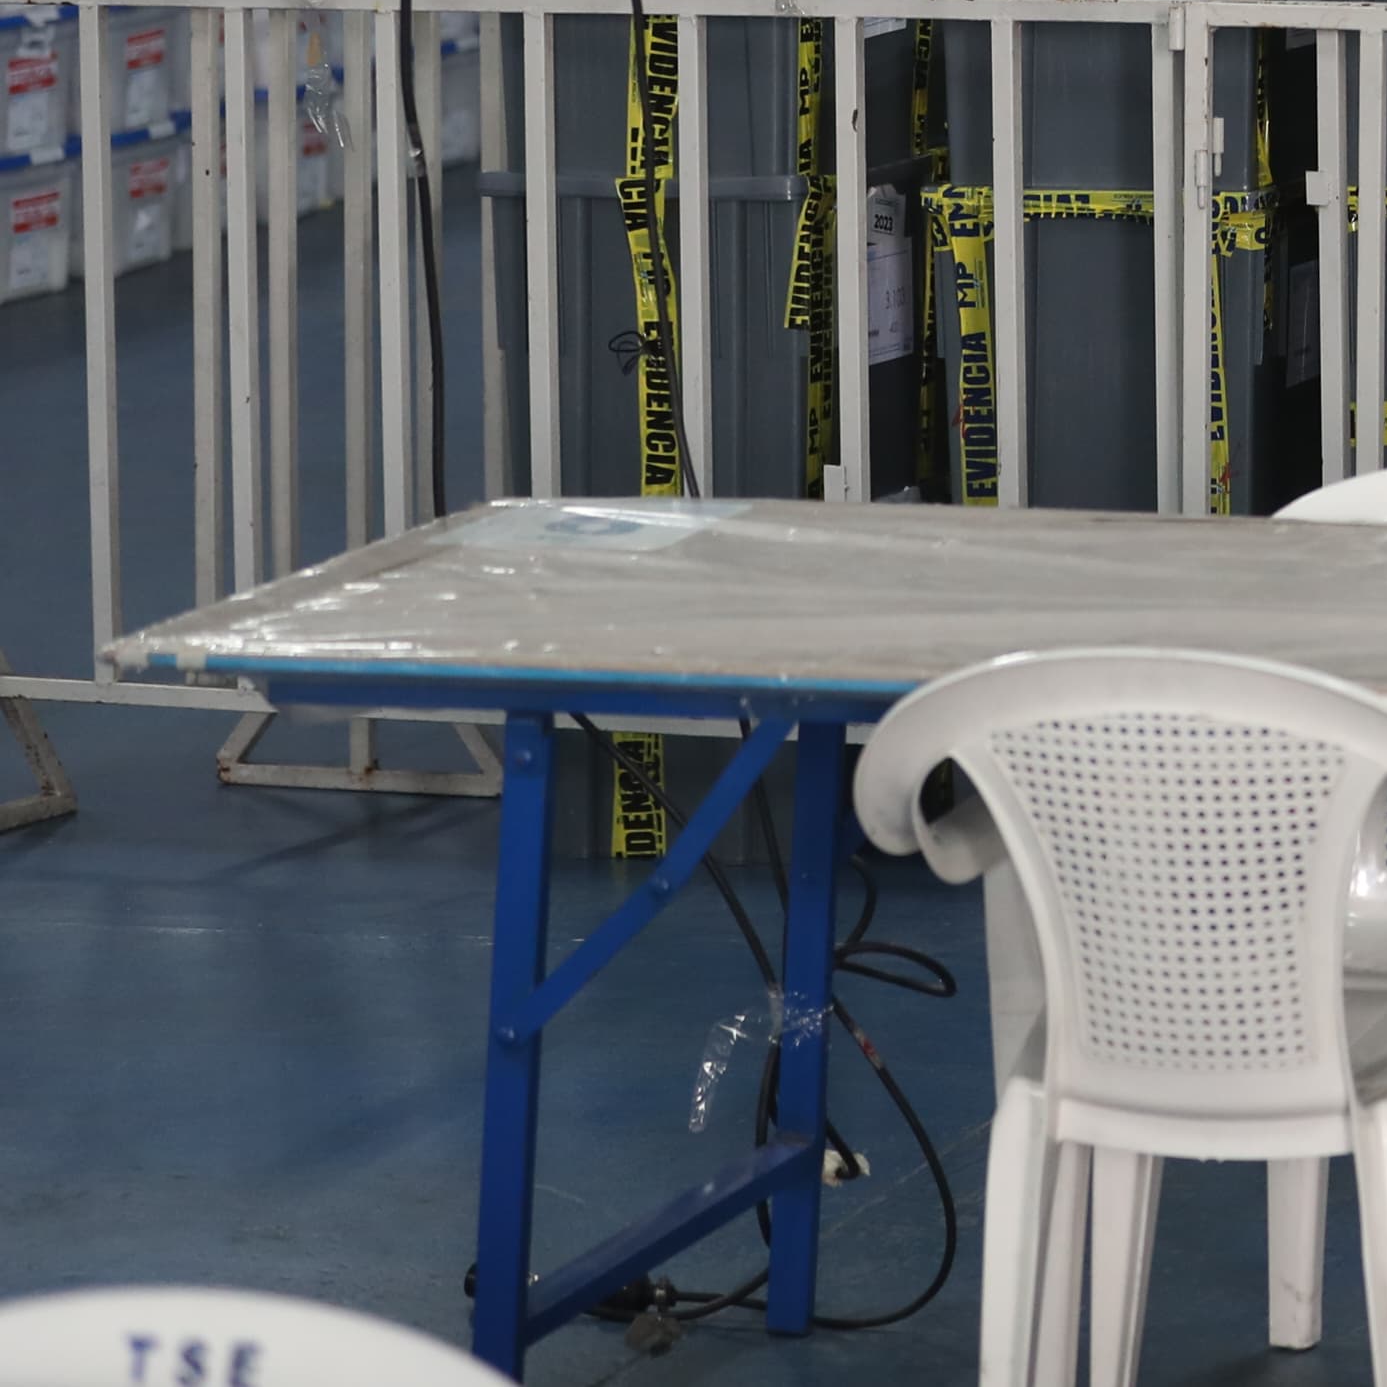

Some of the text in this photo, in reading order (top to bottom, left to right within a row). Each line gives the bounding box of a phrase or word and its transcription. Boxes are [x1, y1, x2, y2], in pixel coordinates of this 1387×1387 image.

[874, 214, 894, 232] 2023
[957, 260, 998, 499] MP EVIDENCIA
[125, 1333, 262, 1387] TSE
